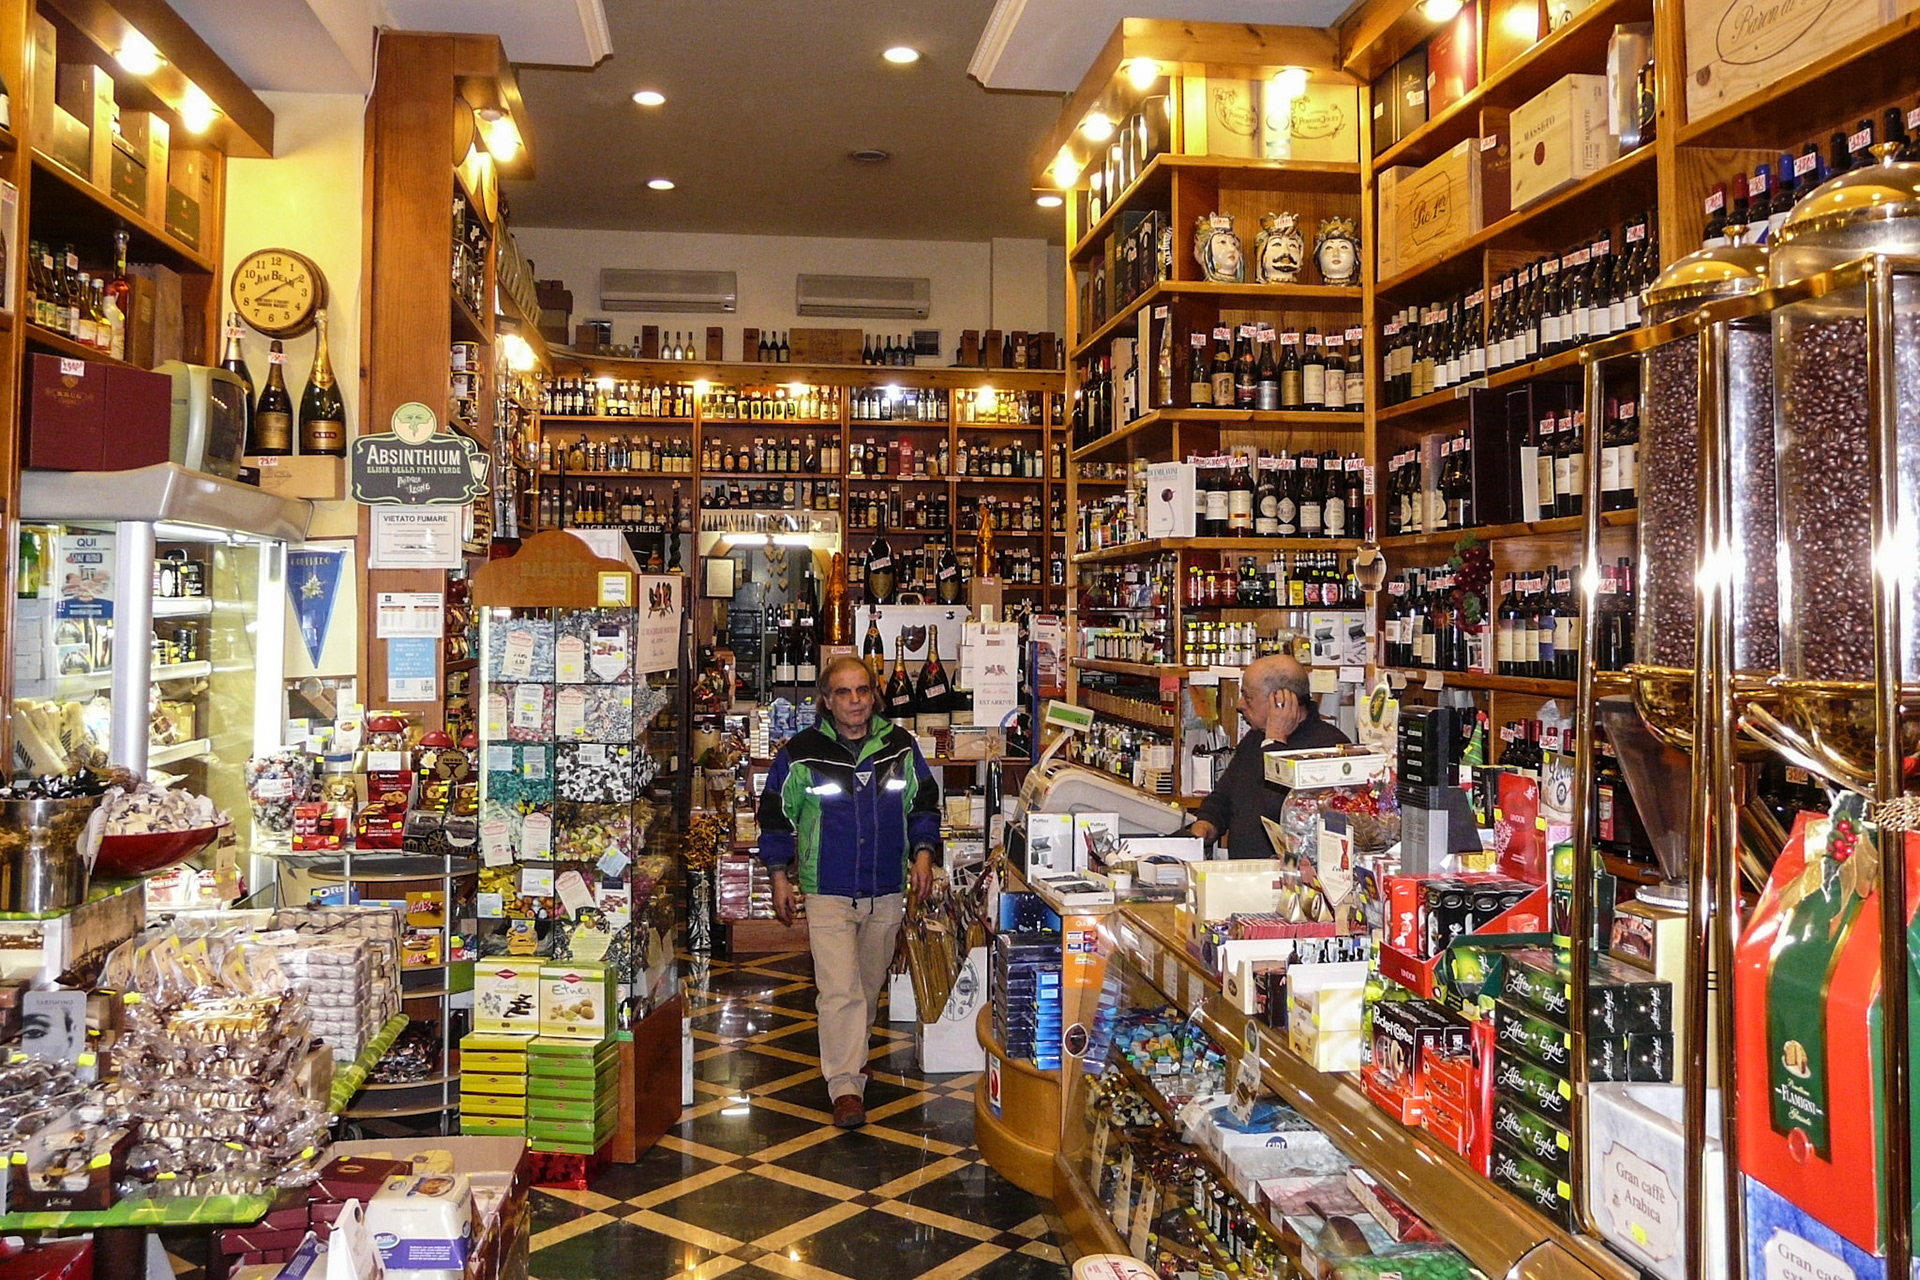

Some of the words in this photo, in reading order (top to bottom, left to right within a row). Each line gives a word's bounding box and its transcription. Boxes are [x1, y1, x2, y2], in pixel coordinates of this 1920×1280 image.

[1524, 115, 1555, 140] MASSETO
[256, 260, 265, 269] 11
[271, 257, 281, 266] 12
[290, 263, 294, 272] 1
[245, 270, 255, 279] 10
[255, 273, 270, 285] JIM
[299, 274, 305, 283] 2
[239, 282, 246, 291] 9
[301, 288, 307, 297] 3
[243, 297, 250, 306] 8
[295, 302, 301, 311] 4
[254, 308, 260, 317] 7
[284, 311, 290, 320] 5
[268, 314, 275, 322] 6
[366, 444, 461, 465] ABSINTHIUM
[367, 466, 390, 474] ELISIR
[392, 466, 415, 474] DELLA
[438, 466, 461, 474] VERDE
[1365, 466, 1373, 493] RIPASSO
[635, 525, 661, 533] HERE
[77, 538, 97, 547] QUI
[421, 684, 434, 693] ups
[1510, 814, 1525, 824] LINDOR
[1400, 969, 1417, 983] LINDOR
[1506, 973, 1532, 998] After
[1543, 987, 1567, 1014] Eight
[1500, 1021, 1529, 1045] After
[1540, 1036, 1565, 1064] Eight
[1498, 1066, 1526, 1092] After
[1537, 1082, 1562, 1112] Eight
[1781, 1083, 1816, 1115] FLAMIGNI
[1496, 1113, 1523, 1138] After
[1533, 1131, 1557, 1160] Eight
[1616, 1162, 1639, 1187] Gran
[1495, 1159, 1522, 1184] After
[1533, 1178, 1557, 1210] Eight
[1624, 1189, 1661, 1224] Arabica
[1778, 1243, 1812, 1272] Gran
